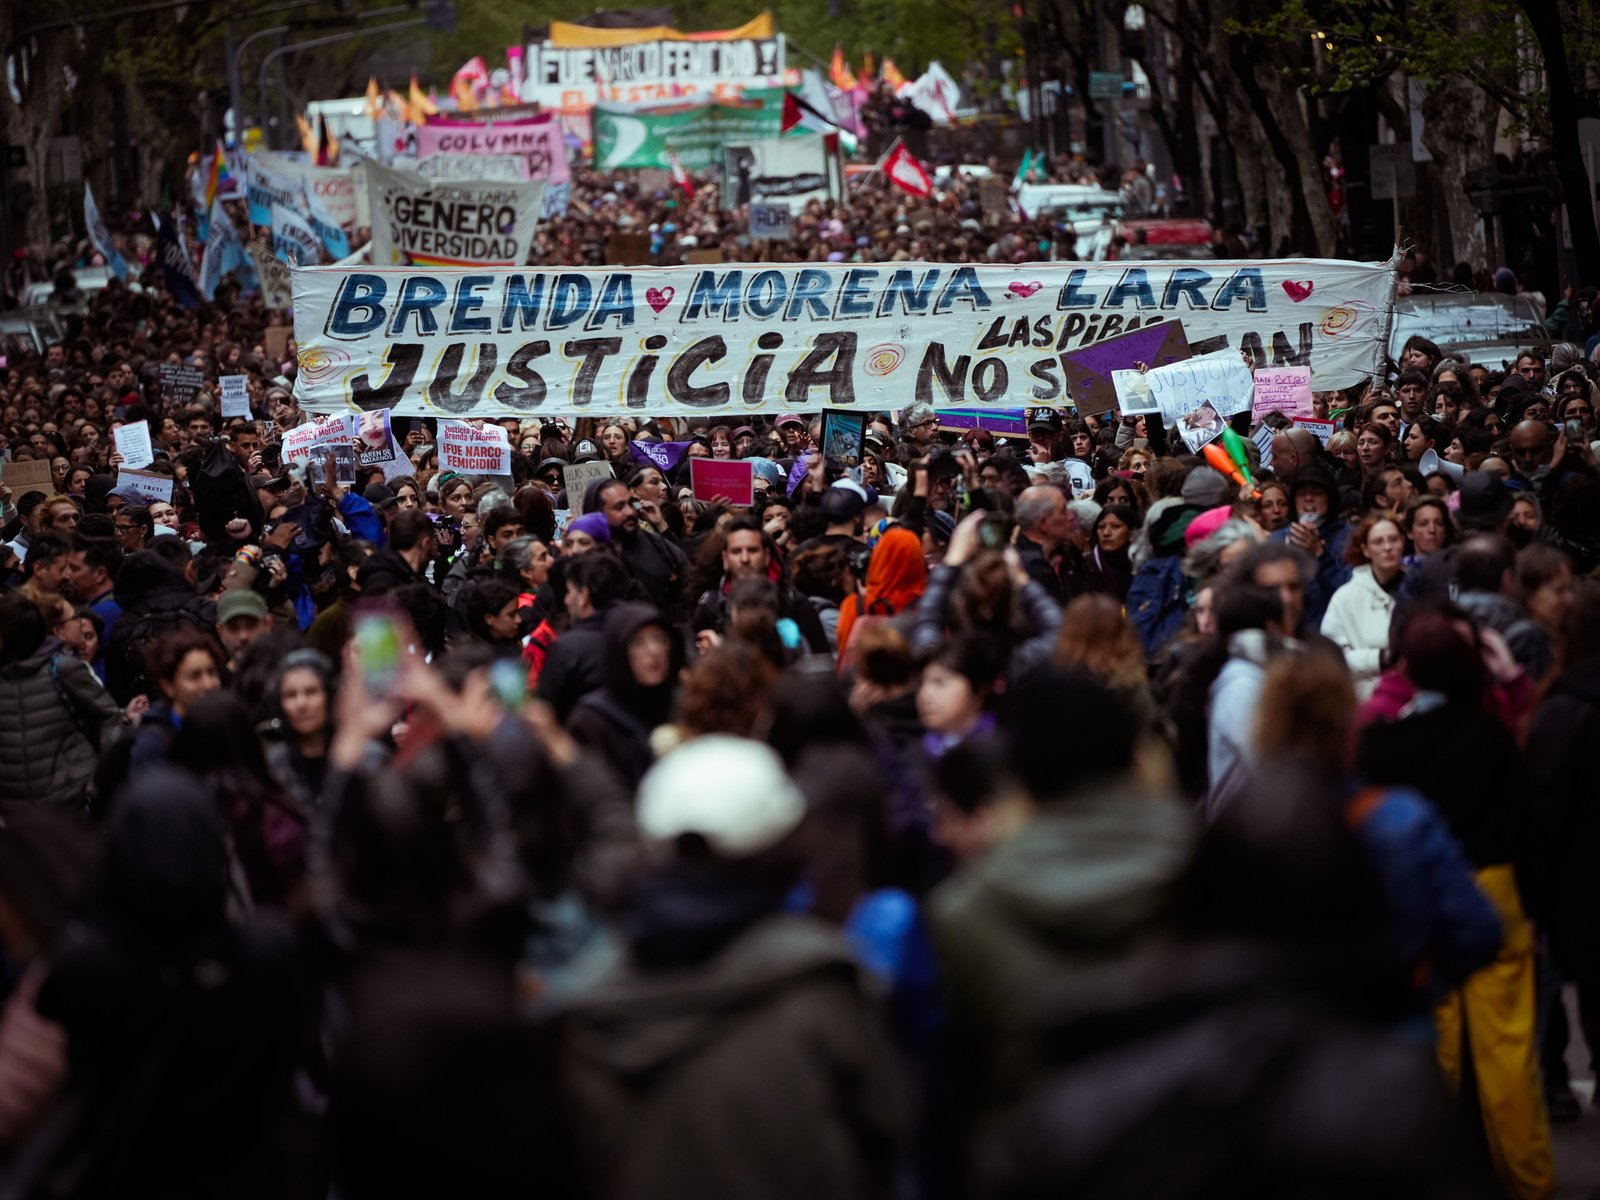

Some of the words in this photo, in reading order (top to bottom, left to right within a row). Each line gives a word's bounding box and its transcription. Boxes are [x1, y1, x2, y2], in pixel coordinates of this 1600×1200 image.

[394, 191, 516, 235] GÉNERO
[324, 273, 636, 341] BRENDA
[680, 267, 991, 323] MORENA
[1057, 267, 1268, 315] LARA
[977, 313, 1054, 350] LAS
[915, 341, 1008, 405] NO
[1153, 359, 1239, 393] JUSTICIA
[318, 425, 345, 437] Morena
[444, 425, 470, 435] Justicia
[444, 432, 468, 441] Brenda
[476, 435, 502, 443] Morena
[443, 443, 463, 456] ¡FUE
[466, 446, 505, 457] NARCO-
[447, 455, 501, 470] FEMICIDIO!
